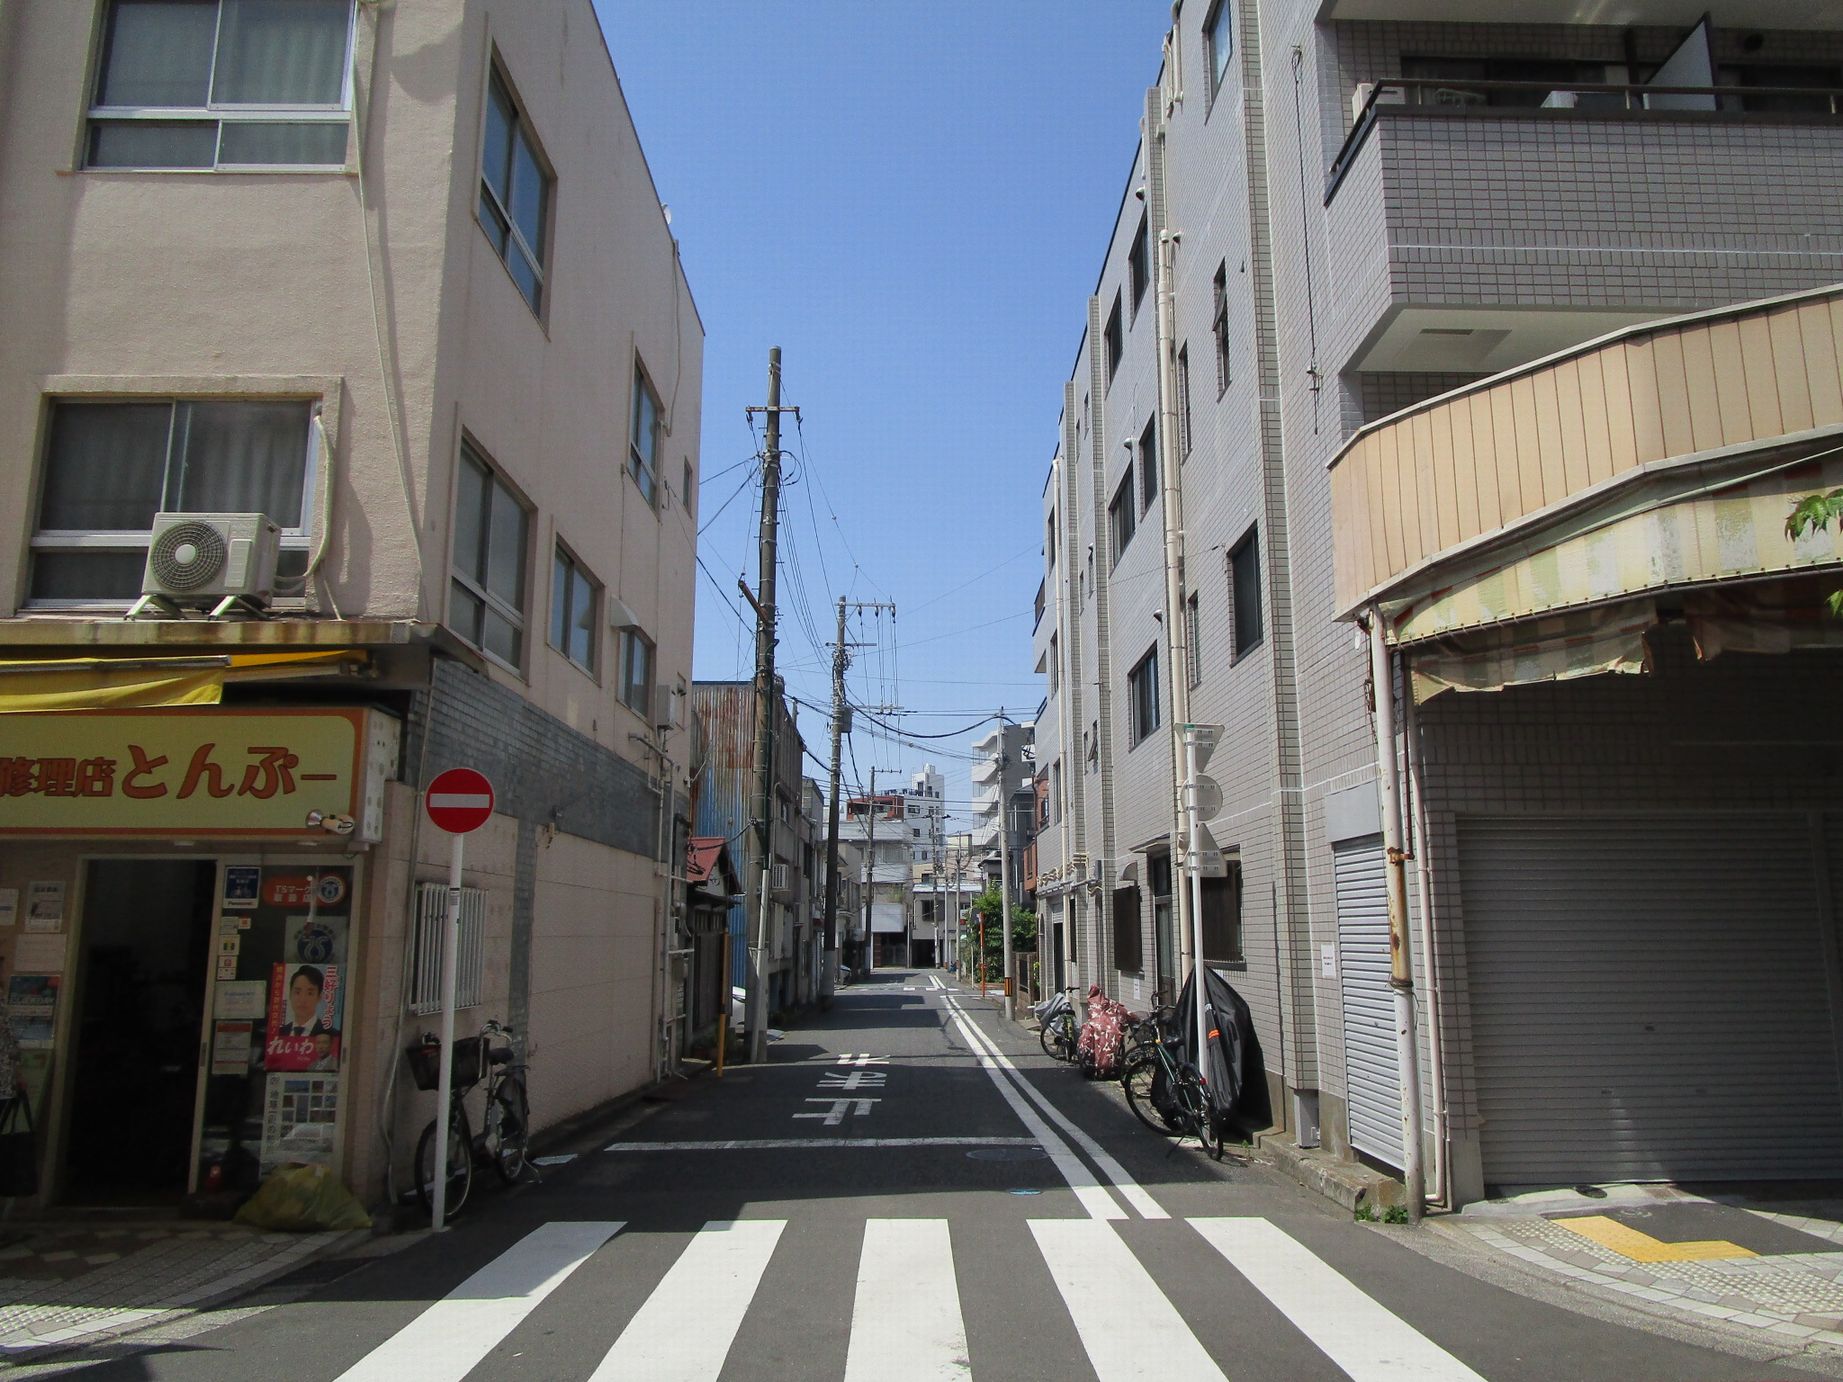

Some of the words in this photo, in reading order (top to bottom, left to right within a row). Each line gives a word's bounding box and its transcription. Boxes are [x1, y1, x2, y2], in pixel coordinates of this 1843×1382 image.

[266, 1036, 314, 1056] れいわ
[791, 1053, 891, 1126] 止まれ
